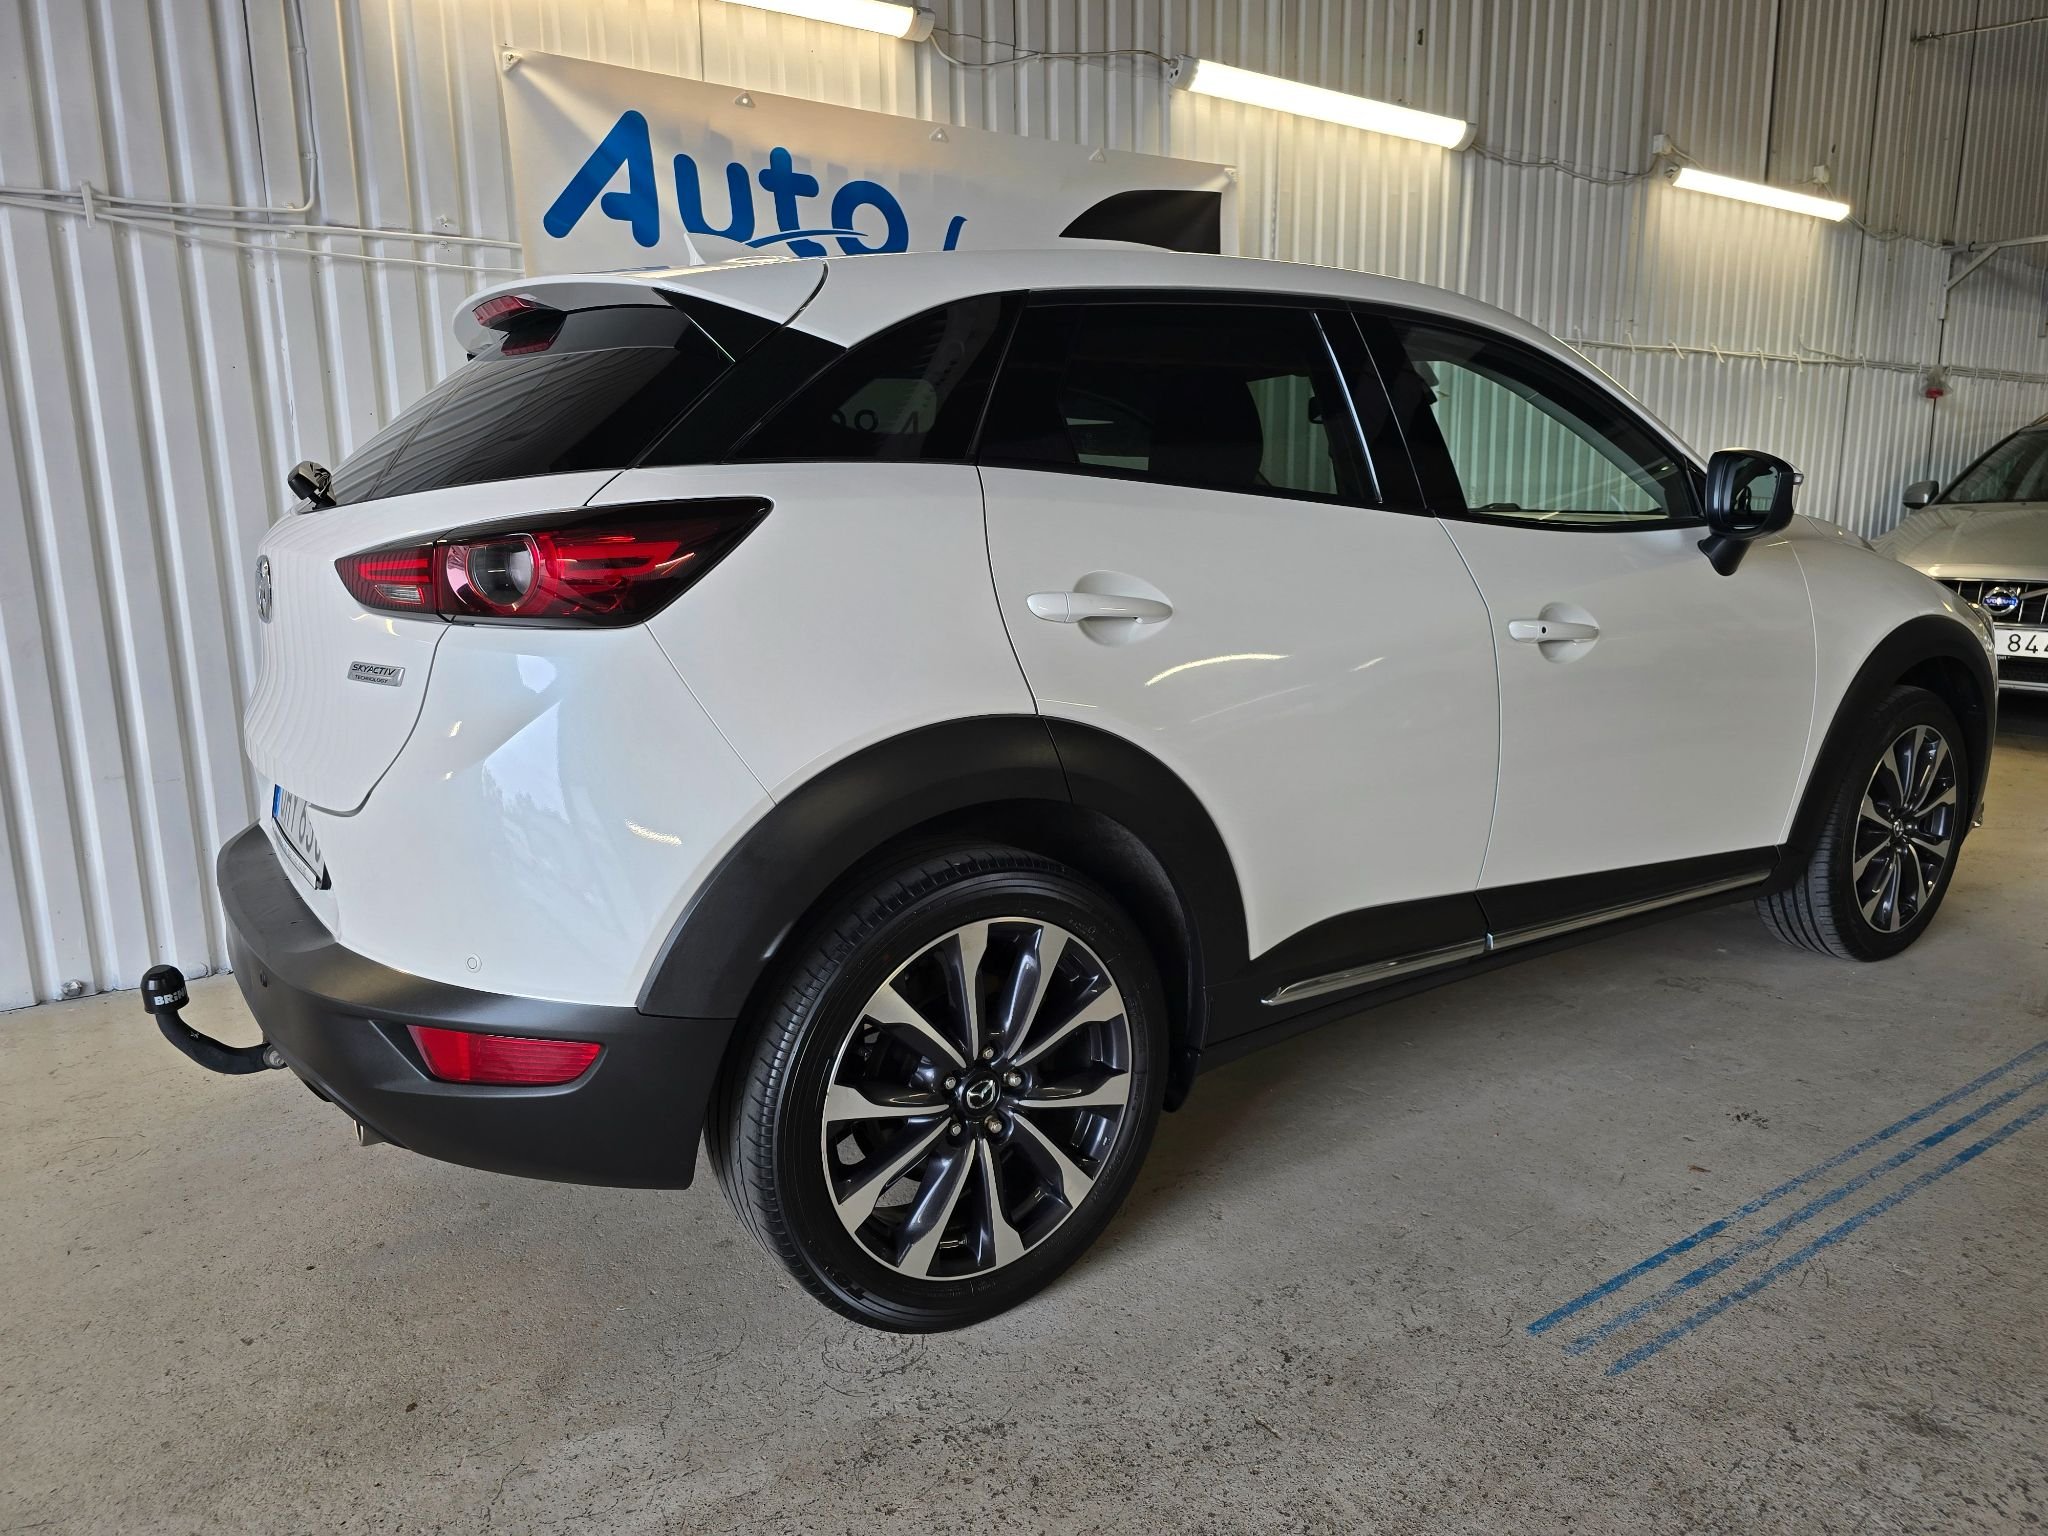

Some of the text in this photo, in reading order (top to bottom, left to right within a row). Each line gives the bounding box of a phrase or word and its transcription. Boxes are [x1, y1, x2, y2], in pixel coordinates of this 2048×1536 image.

[543, 110, 909, 257] Auto
[2007, 633, 2048, 654] 84
[351, 663, 396, 676] SKYACTIV
[355, 674, 389, 684] TECHNOLOGY
